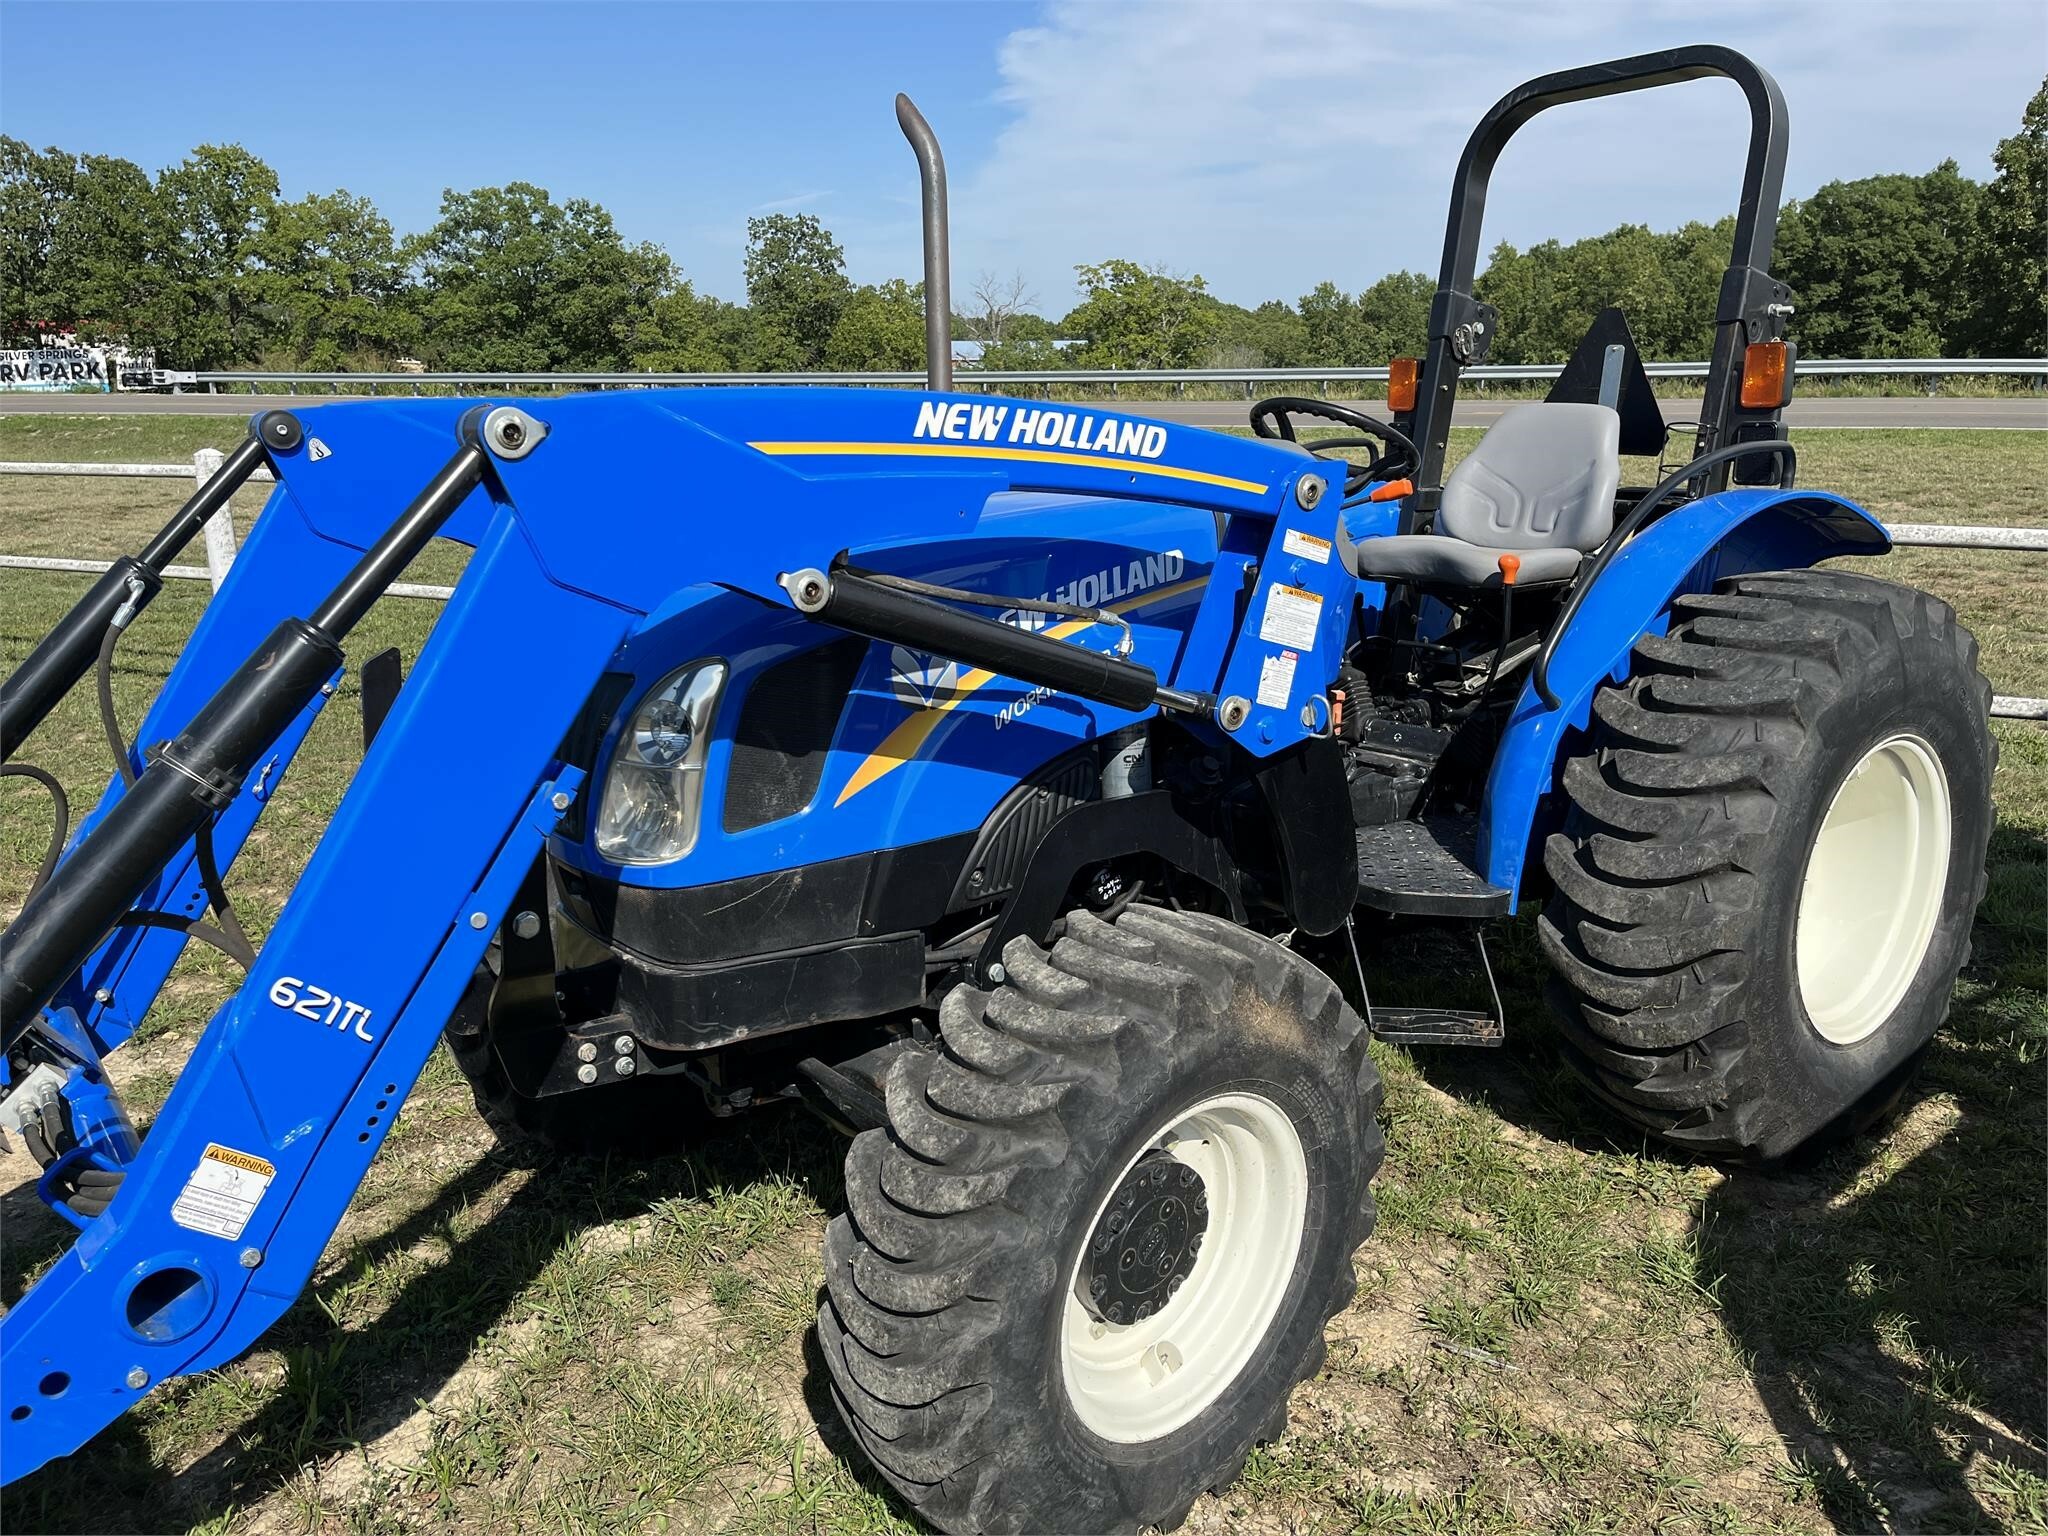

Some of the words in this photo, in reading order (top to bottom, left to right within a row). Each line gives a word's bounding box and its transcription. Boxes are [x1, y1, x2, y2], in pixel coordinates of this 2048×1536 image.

[0, 351, 35, 361] SILVER
[39, 349, 89, 361] SPRINGS
[0, 363, 30, 383] RV
[39, 361, 104, 381] PARK
[913, 401, 1008, 442] NEW
[1008, 408, 1167, 459] HOLLAND
[1056, 549, 1184, 621] HOLLAND
[1292, 589, 1319, 602] WARNING
[269, 976, 374, 1042] 621TL
[221, 1152, 274, 1175] WARNING
